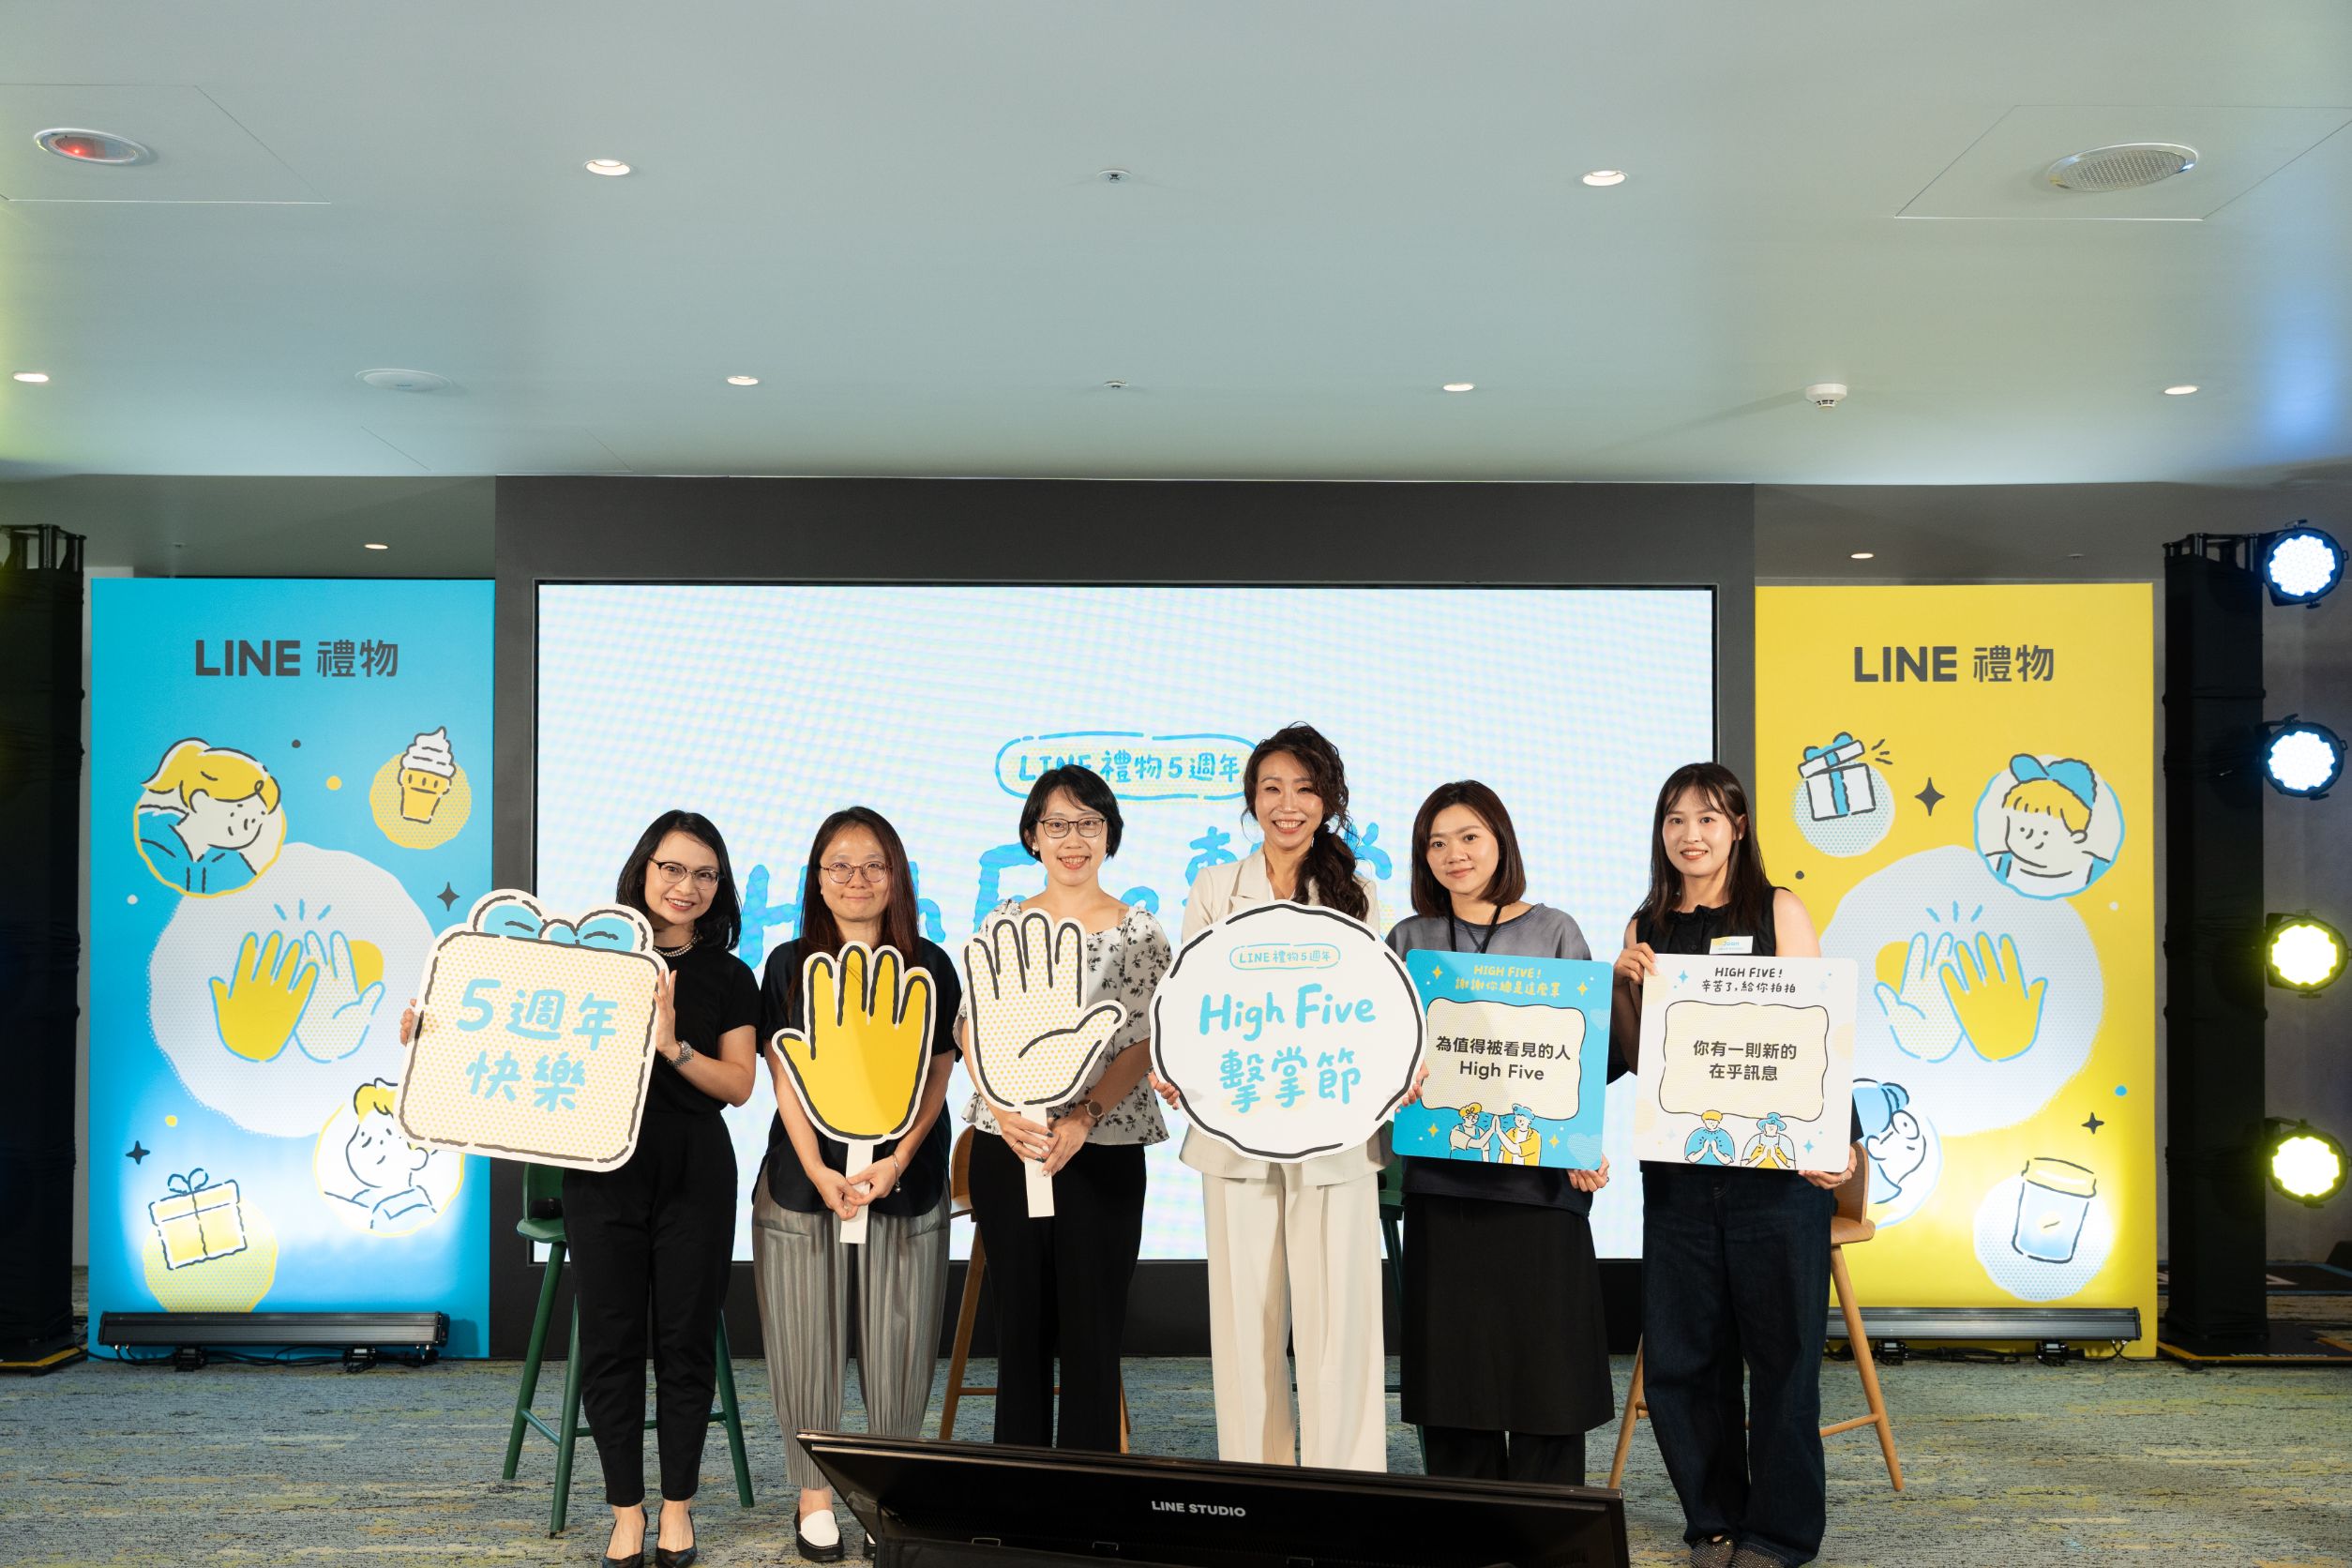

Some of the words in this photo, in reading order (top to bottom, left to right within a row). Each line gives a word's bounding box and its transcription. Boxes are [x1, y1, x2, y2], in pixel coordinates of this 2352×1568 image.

[195, 640, 300, 676] LINE
[317, 640, 399, 677] 禮物
[1854, 646, 1957, 682] LINE
[1973, 644, 2054, 683] 禮物
[1100, 749, 1240, 782] 禮物5週年
[1239, 952, 1270, 963] LINE
[1473, 964, 1505, 976] HIGH
[1714, 967, 1745, 978] HIGH
[457, 978, 618, 1050] 5週年
[1199, 991, 1285, 1041] High
[1296, 983, 1377, 1029] Five
[1436, 1035, 1571, 1061] 為值得被看見的人
[1694, 1040, 1797, 1060] 你有一則新的
[465, 1050, 586, 1112] 快樂
[1219, 1046, 1361, 1113] 擊掌節
[1459, 1061, 1500, 1080] High
[1508, 1063, 1545, 1080] Five
[1709, 1063, 1778, 1081] 在乎訊息
[1152, 1500, 1185, 1513] LINE
[1188, 1503, 1246, 1516] STUDIO
